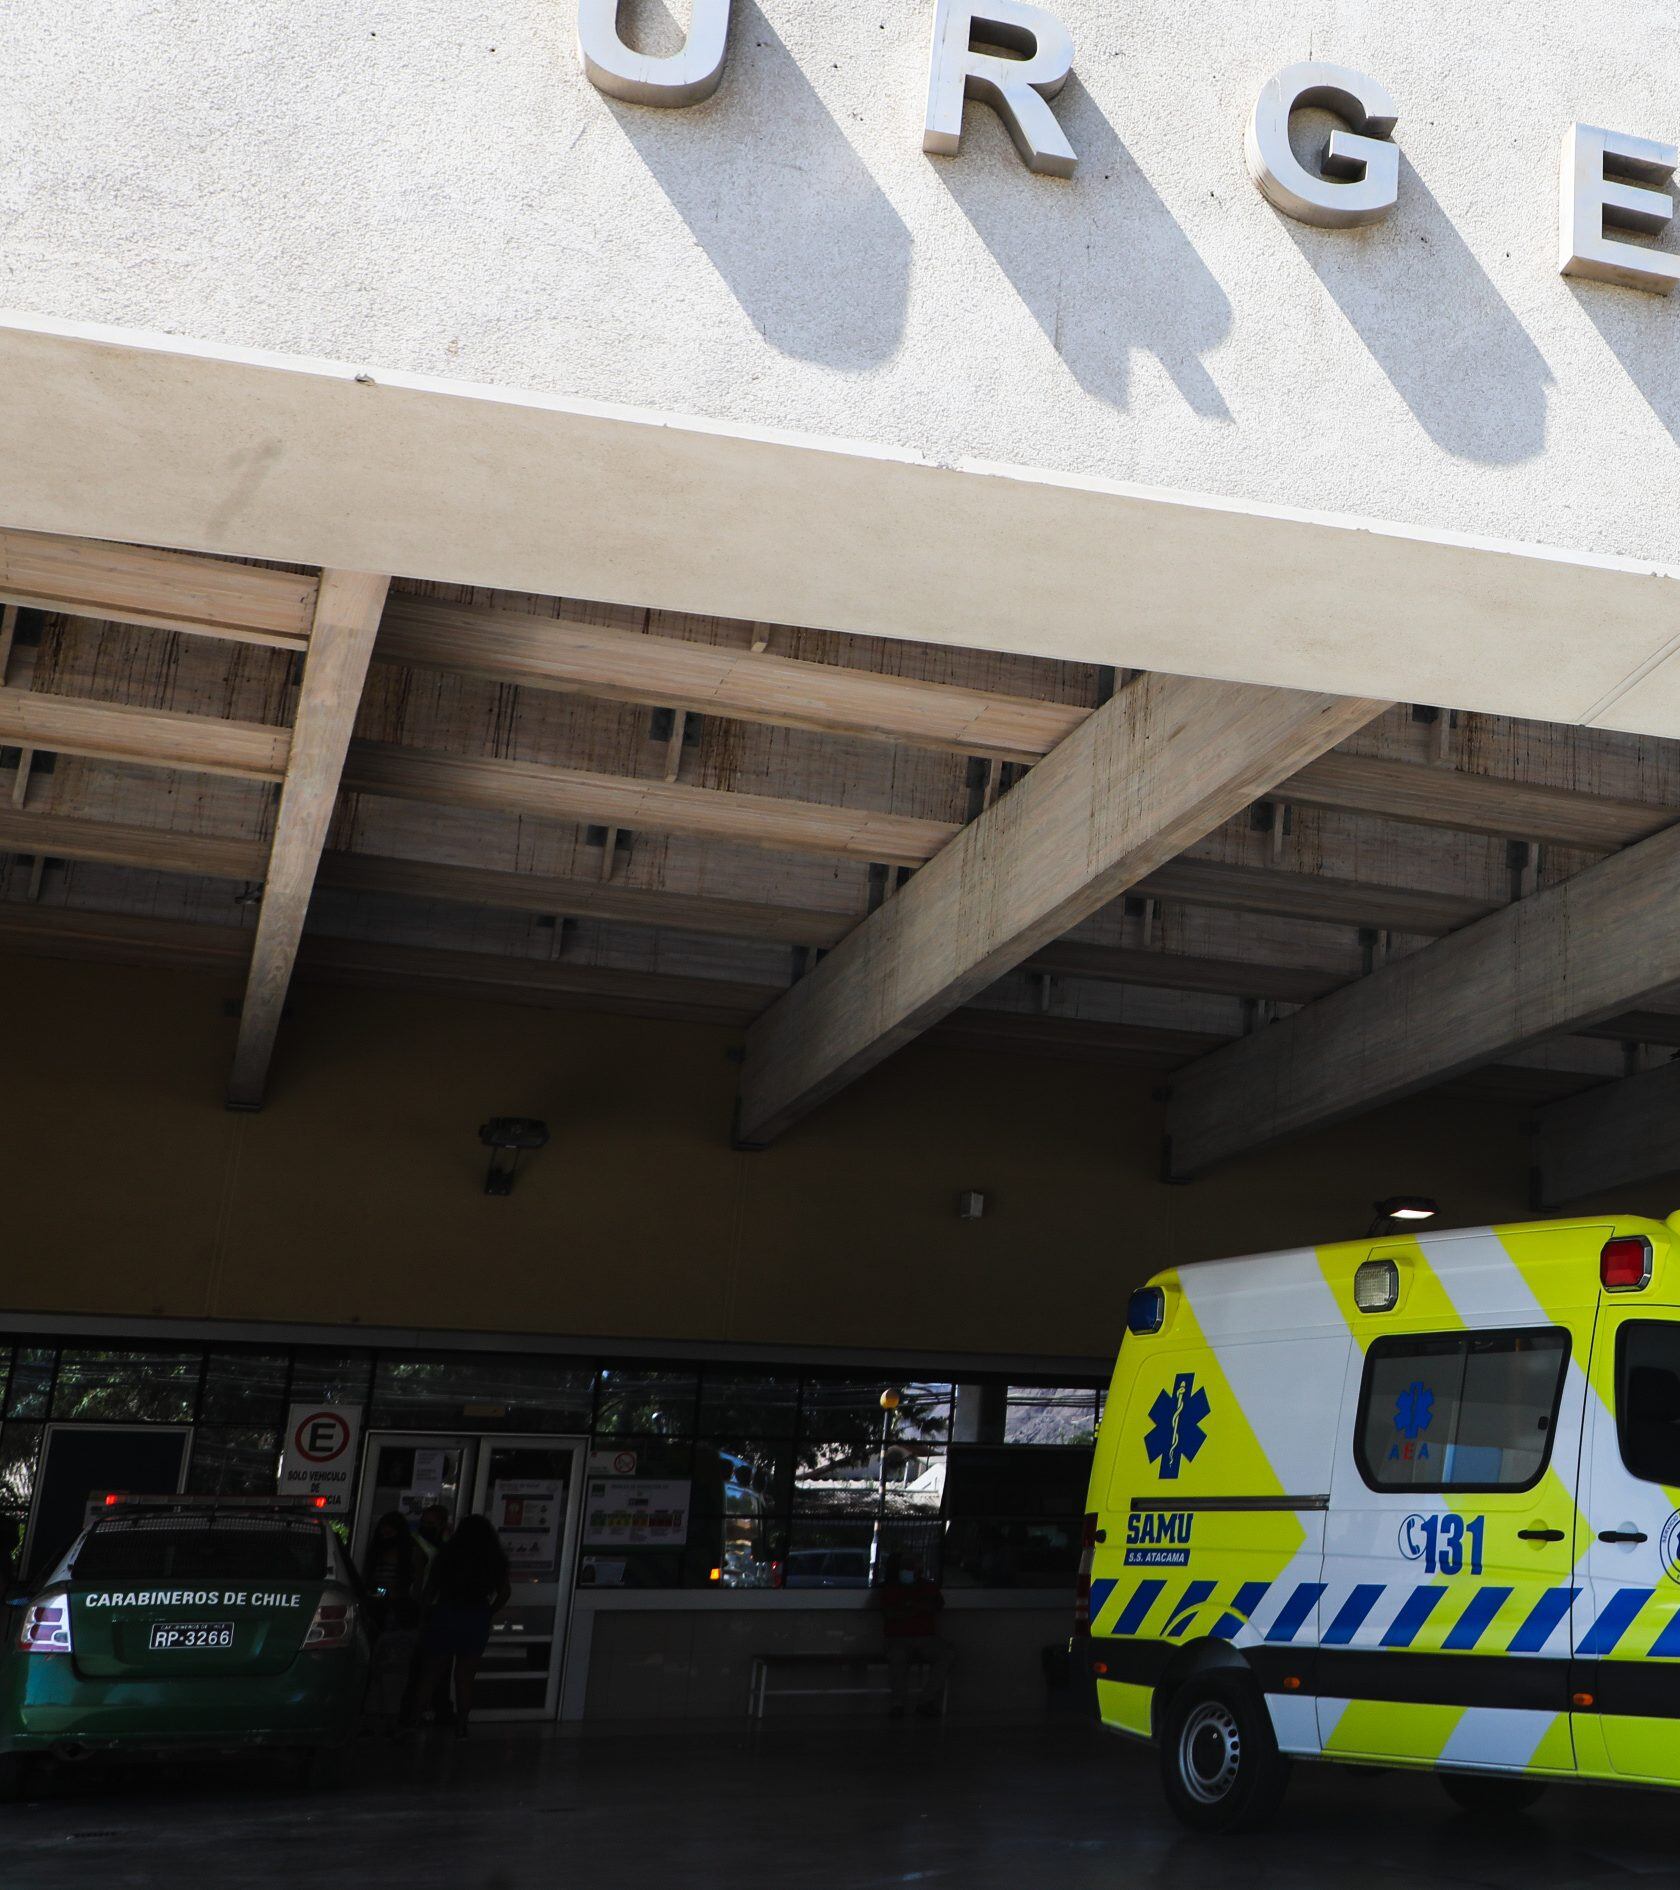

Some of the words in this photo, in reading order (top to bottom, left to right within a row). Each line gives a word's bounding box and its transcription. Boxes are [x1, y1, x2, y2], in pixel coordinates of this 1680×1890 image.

[308, 1422, 336, 1452] E
[287, 1471, 307, 1481] SOLO
[309, 1471, 347, 1481] VEHICULO
[311, 1483, 320, 1493] DE
[1126, 1513, 1194, 1544] SAMU
[1420, 1513, 1485, 1576] 131
[1128, 1552, 1144, 1562] S.S.
[1145, 1552, 1185, 1562] ATACAMA
[86, 1591, 219, 1607] CARABINEROS
[222, 1592, 247, 1606] DE
[251, 1593, 302, 1608] CHILE
